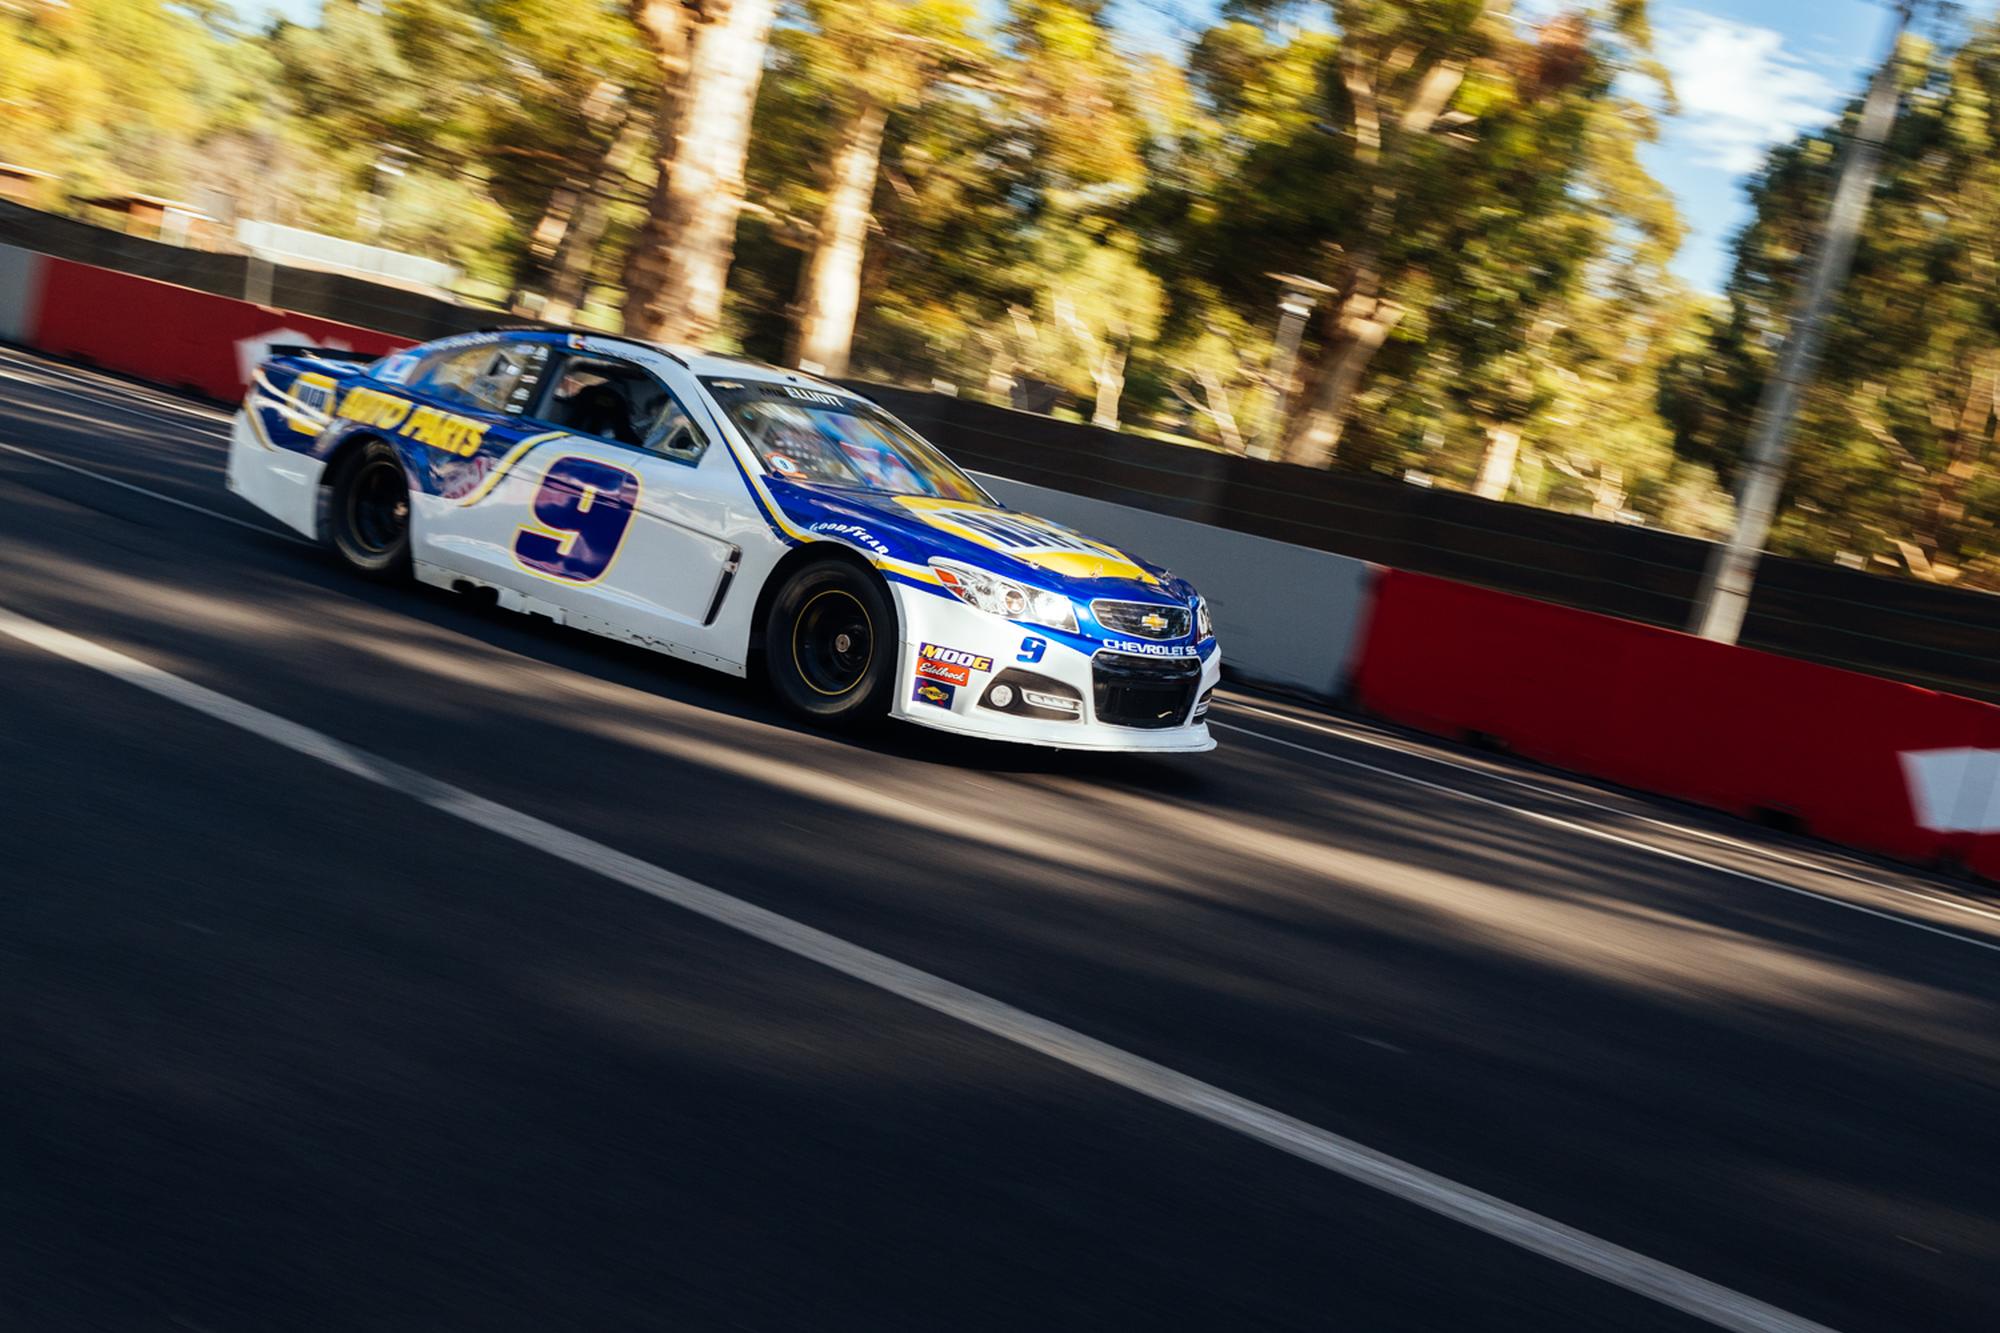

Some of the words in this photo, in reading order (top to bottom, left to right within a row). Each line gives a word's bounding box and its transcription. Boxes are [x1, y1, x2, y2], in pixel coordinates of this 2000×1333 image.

[783, 386, 844, 408] ELLIOTT
[398, 405, 492, 457] PARTS
[509, 452, 644, 589] 9
[922, 644, 991, 671] MOOG
[1016, 636, 1047, 664] 9
[1103, 639, 1184, 656] CHEVROLET
[1185, 646, 1197, 656] SS
[919, 662, 965, 682] Edelbrock
